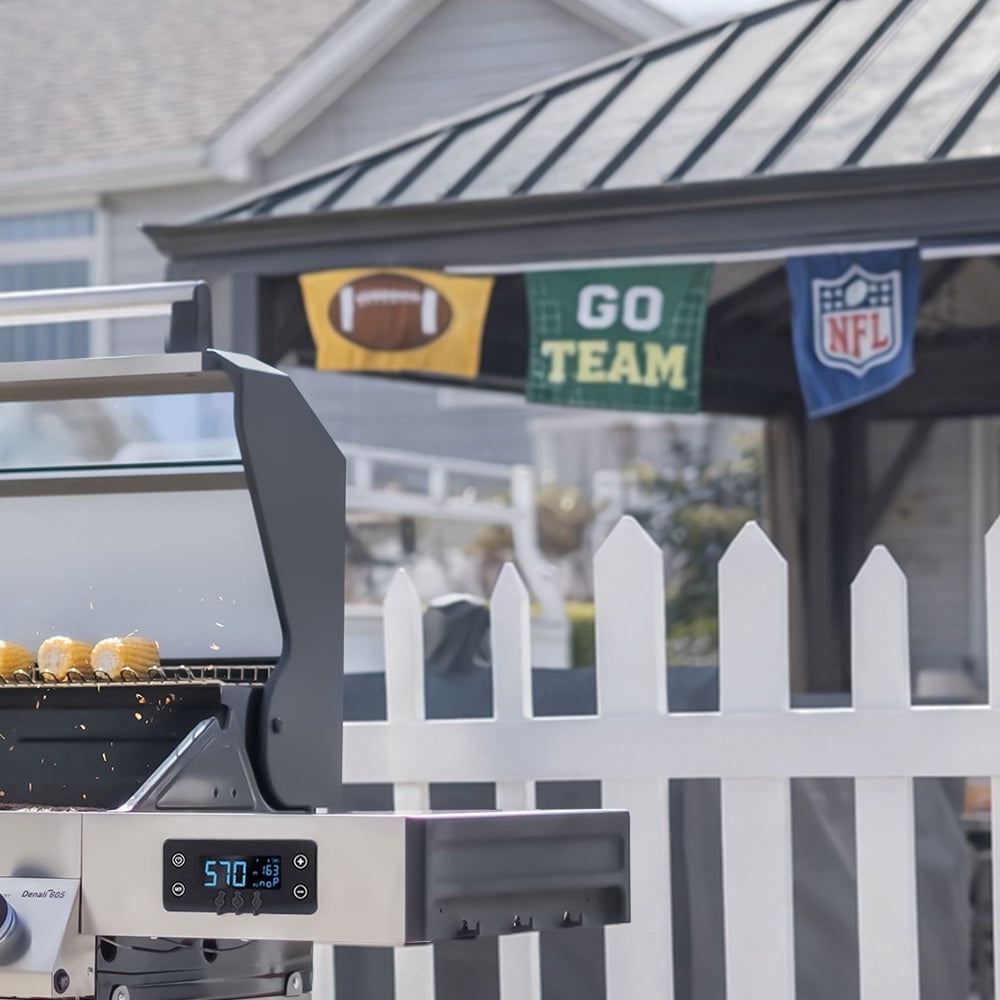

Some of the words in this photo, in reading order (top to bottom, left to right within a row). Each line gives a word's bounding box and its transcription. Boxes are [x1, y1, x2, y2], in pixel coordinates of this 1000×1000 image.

[576, 284, 664, 332] GO
[828, 312, 889, 359] NFL
[541, 339, 687, 390] TEAM
[21, 890, 48, 898] Denali
[203, 860, 247, 887] 570
